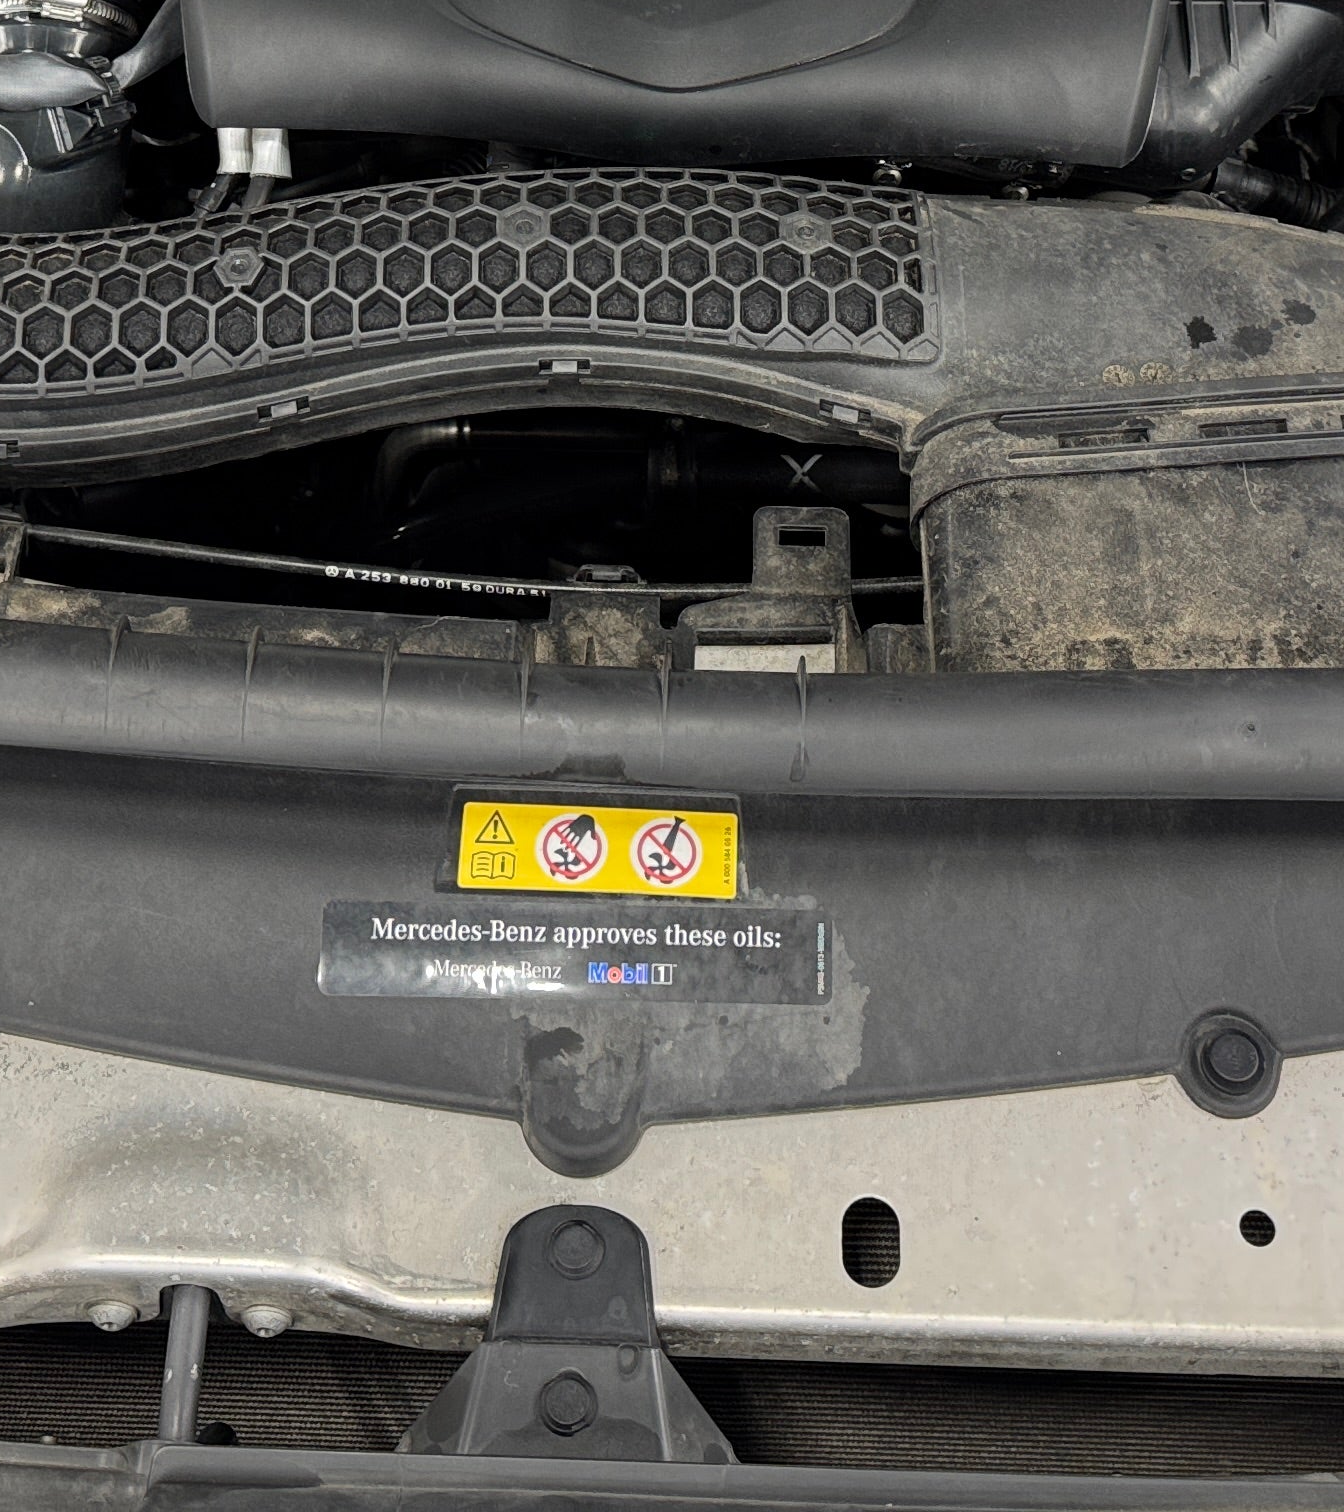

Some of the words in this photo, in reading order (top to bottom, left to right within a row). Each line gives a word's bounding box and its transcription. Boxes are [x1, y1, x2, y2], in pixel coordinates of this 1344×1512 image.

[345, 568, 357, 579] A
[361, 570, 392, 583] 253
[436, 579, 452, 589] 01
[486, 585, 526, 595] DURA
[370, 917, 548, 943] Mercedes-Benz
[552, 925, 658, 950] approves
[663, 923, 727, 947] these
[732, 925, 782, 949] oils:
[587, 962, 649, 984] Mobil
